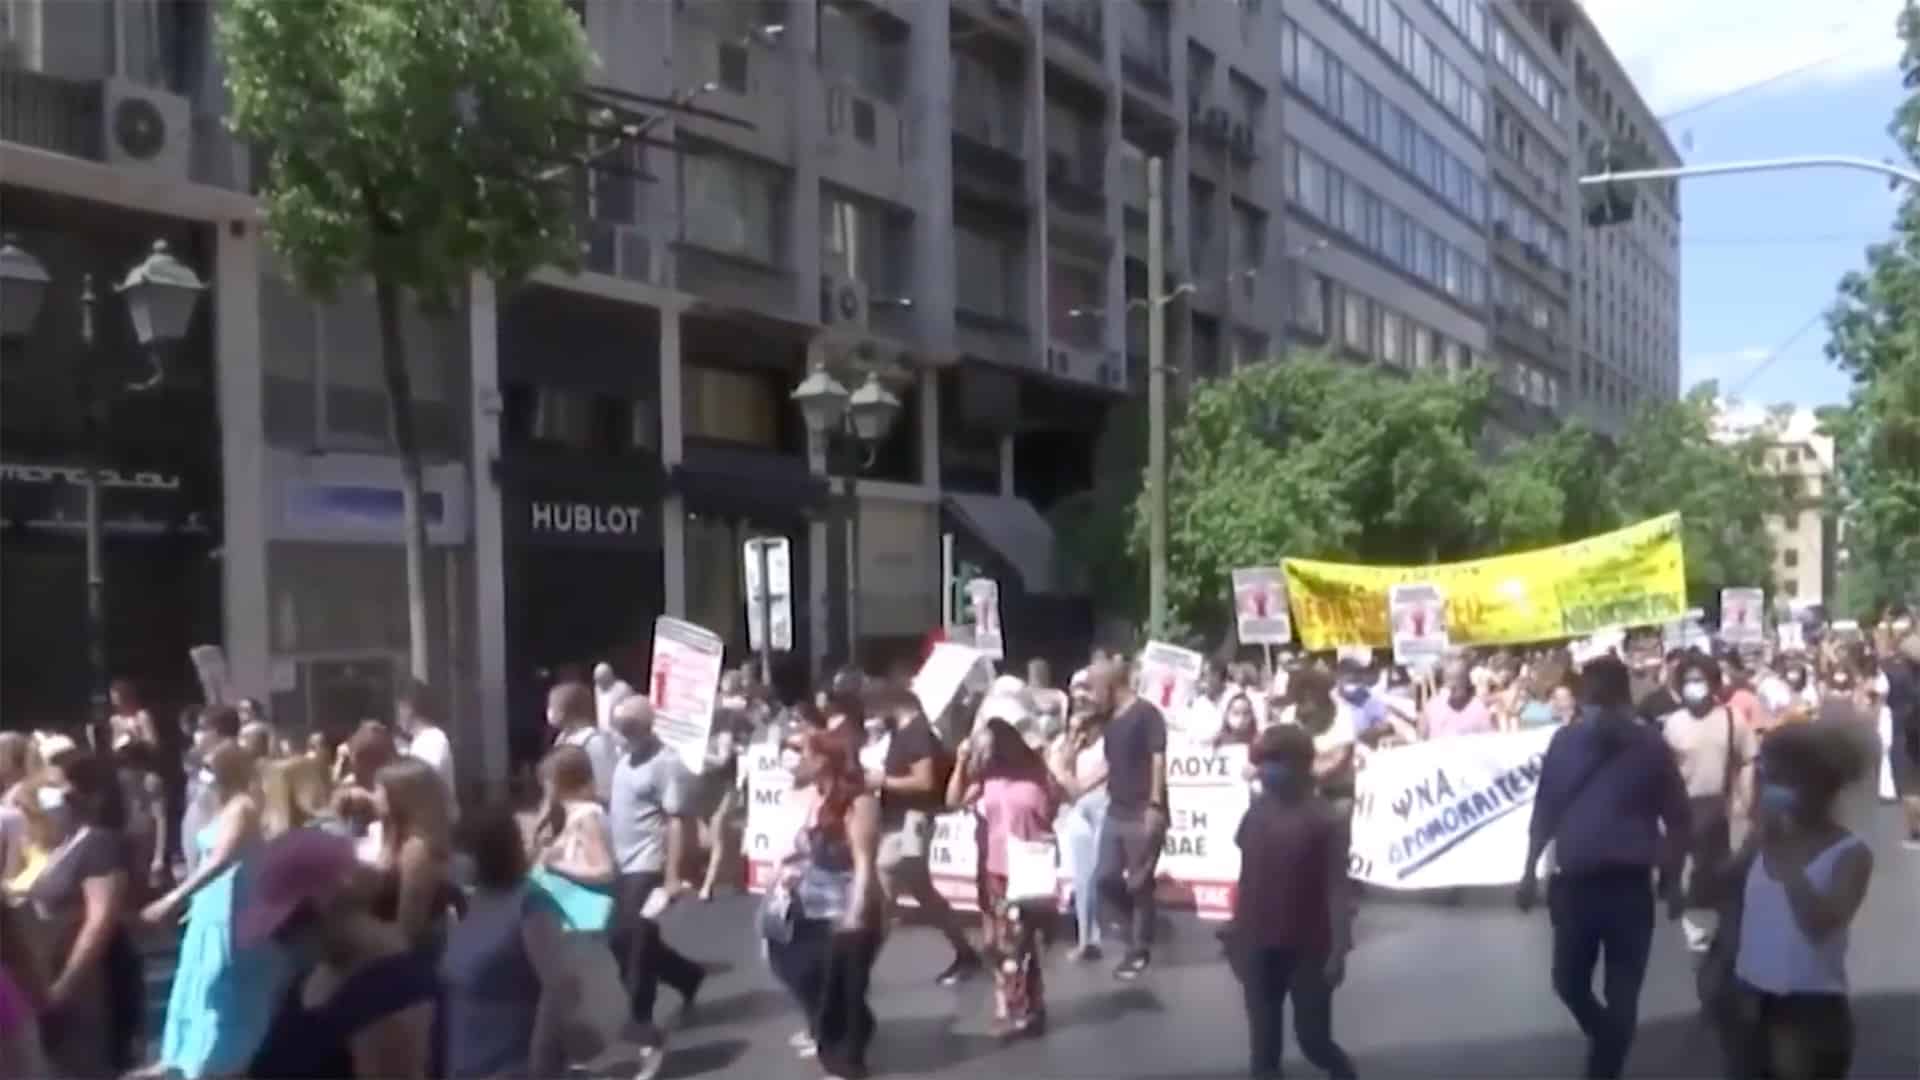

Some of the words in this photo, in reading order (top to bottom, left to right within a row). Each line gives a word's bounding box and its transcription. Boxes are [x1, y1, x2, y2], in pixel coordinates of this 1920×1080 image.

[531, 502, 641, 534] HUBLOT
[1169, 756, 1229, 776] ΛΟΥΣ
[1176, 810, 1207, 829] ΞΗ
